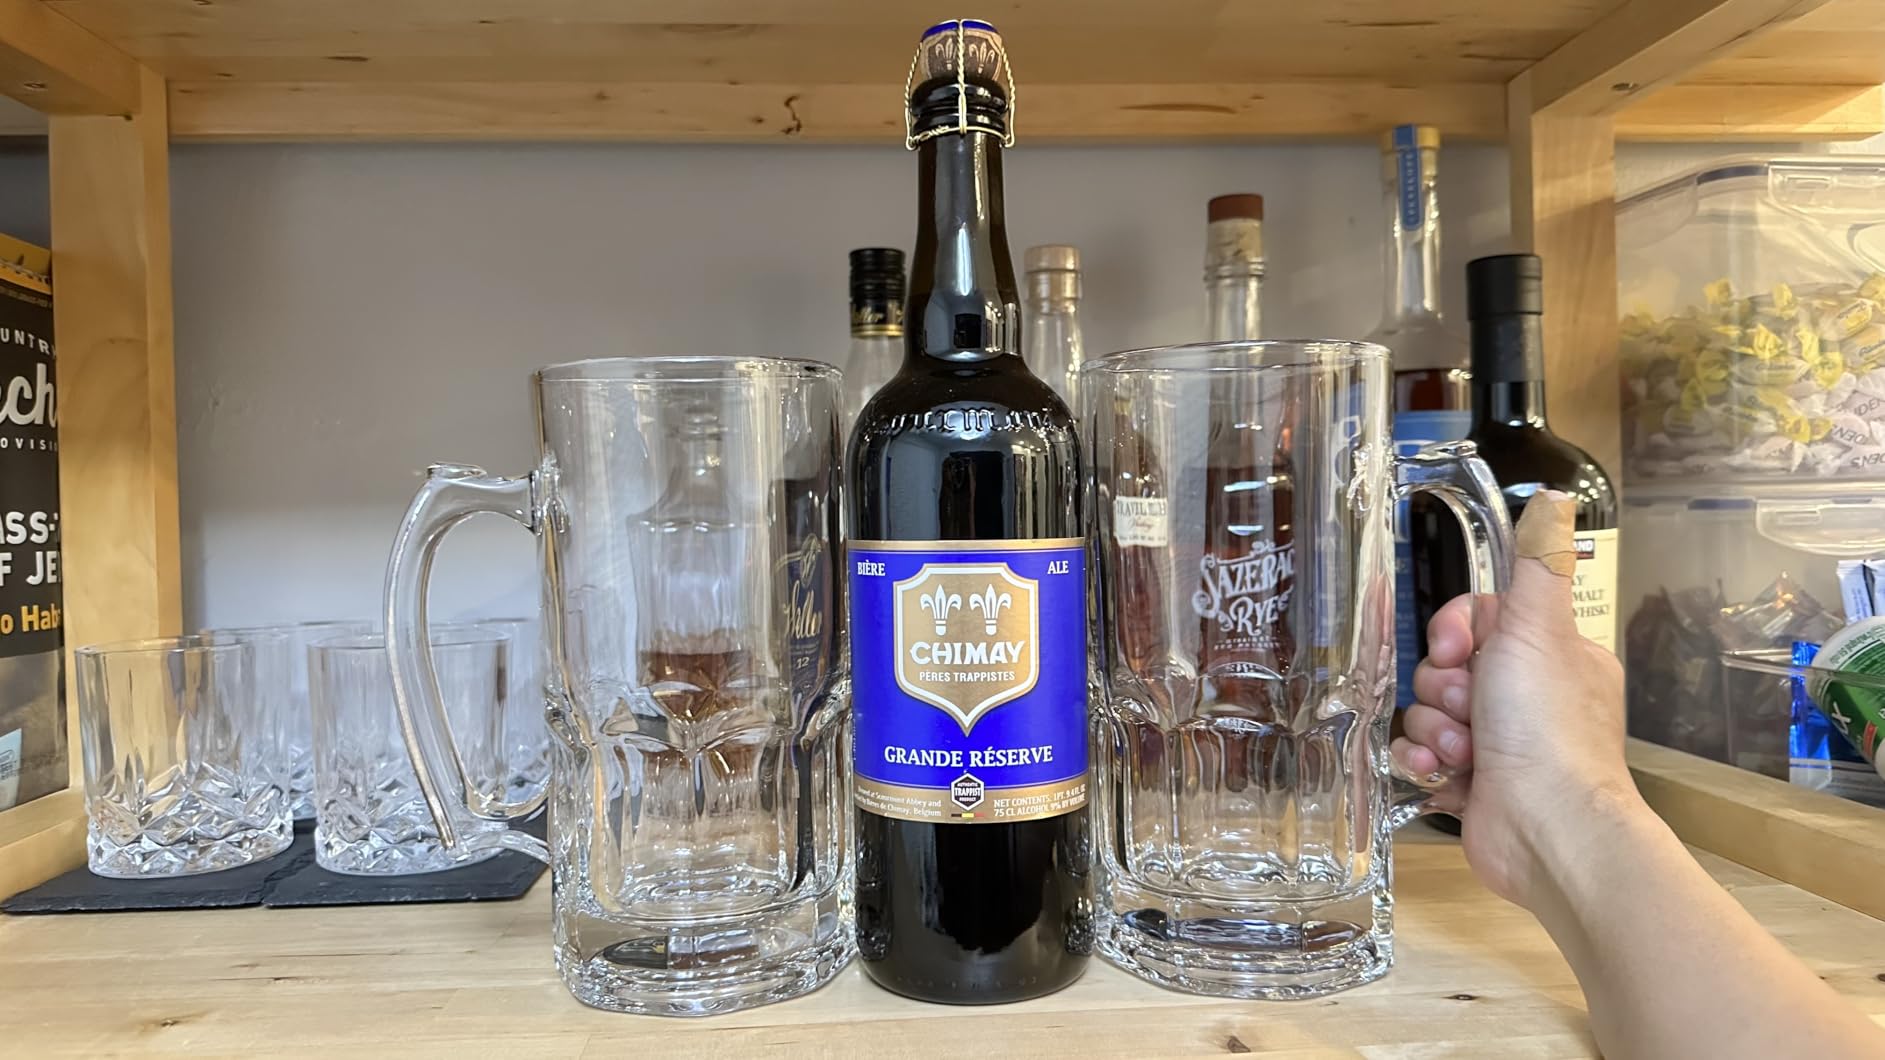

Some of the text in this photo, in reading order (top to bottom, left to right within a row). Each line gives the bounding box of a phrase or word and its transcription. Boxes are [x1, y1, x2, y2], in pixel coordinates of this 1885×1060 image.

[1574, 540, 1594, 552] ND
[26, 550, 61, 585] JE
[857, 560, 886, 576] BIÈRE
[1047, 560, 1069, 575] ALE
[1572, 574, 1586, 586] Y
[21, 603, 60, 632] Hab
[1229, 596, 1279, 637] RYE
[909, 640, 1026, 665] CHIMAY
[953, 671, 1016, 682] TRAPPISTES
[884, 745, 1054, 768] GRANDE RÉSERVE
[954, 787, 981, 797] TRAPPIST
[994, 800, 1010, 808] NET
[994, 808, 1005, 817] 75
[1006, 807, 1016, 815] CL
[1017, 804, 1049, 815] ALCOHOL
[914, 807, 942, 817] Belgium
